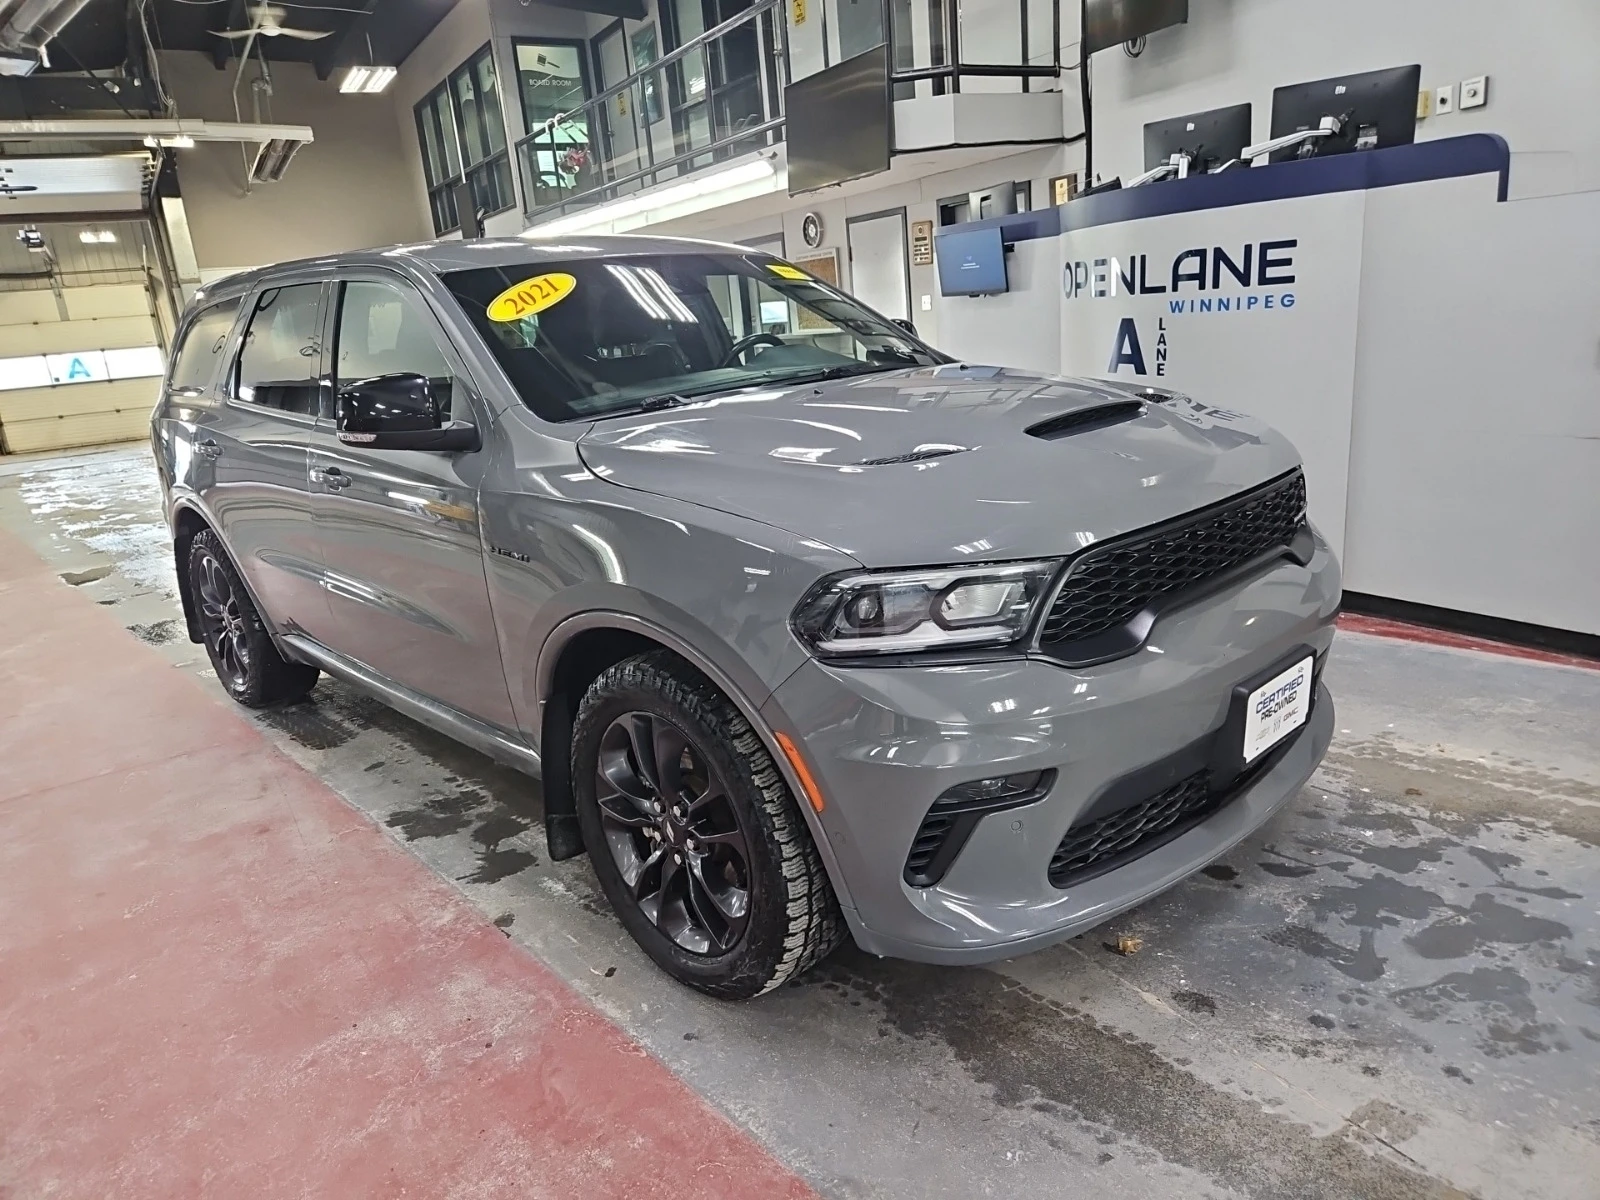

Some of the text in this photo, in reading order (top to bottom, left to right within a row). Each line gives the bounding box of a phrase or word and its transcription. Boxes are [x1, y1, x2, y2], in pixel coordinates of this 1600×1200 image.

[1063, 239, 1297, 298] OPENLANE
[503, 278, 559, 315] 2021
[1169, 293, 1295, 314] WINNIPEG
[1107, 317, 1147, 376] A
[1156, 317, 1167, 377] LANE
[69, 358, 91, 379] A
[1256, 674, 1304, 714] CERTIFIED
[1261, 690, 1297, 723] PRE-OWNED
